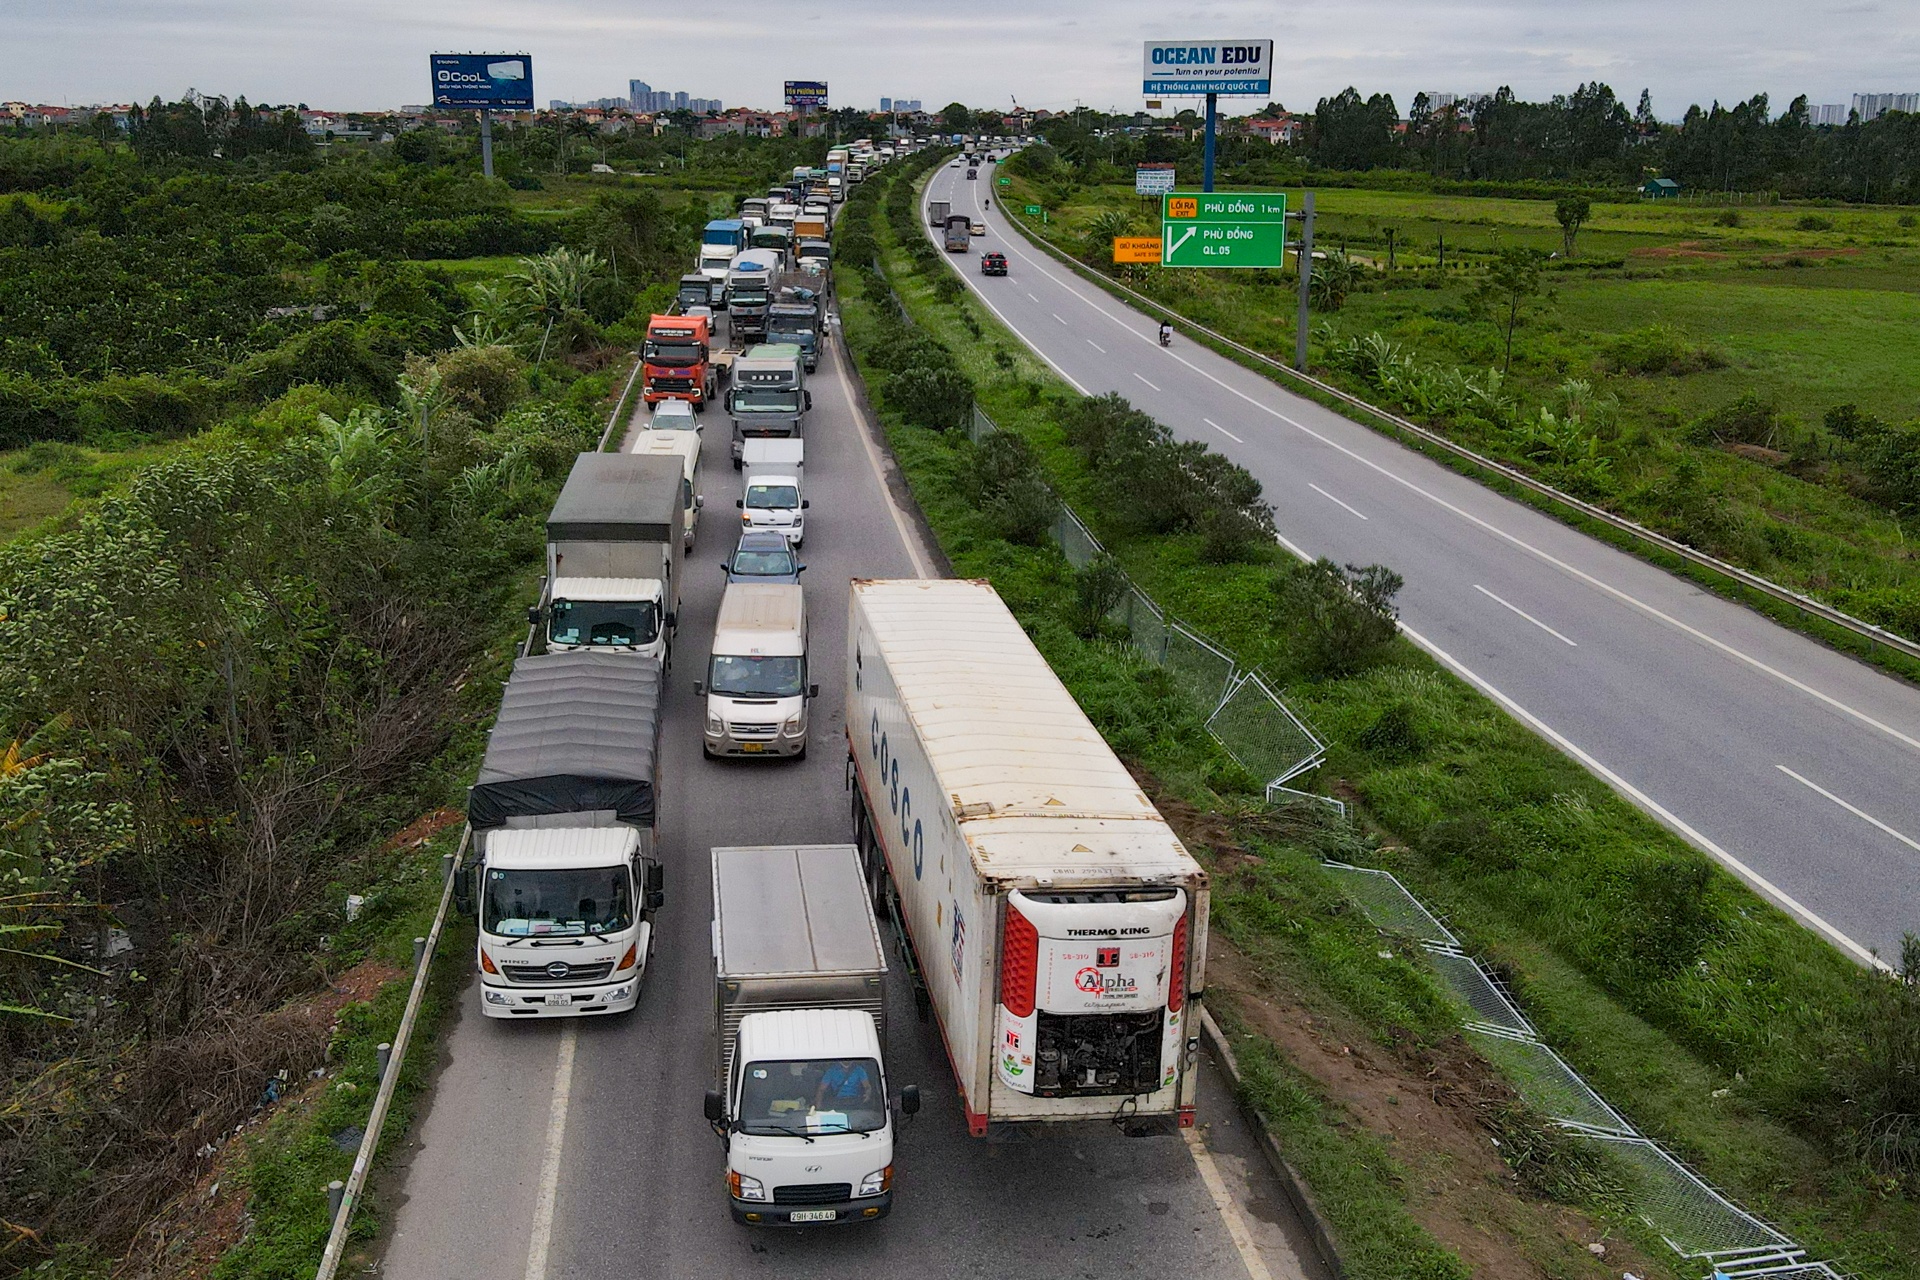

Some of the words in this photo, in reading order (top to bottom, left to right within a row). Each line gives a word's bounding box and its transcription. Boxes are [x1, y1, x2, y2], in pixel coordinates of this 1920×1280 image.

[1152, 47, 1216, 64] OCEAN
[1222, 46, 1261, 64] EDU
[1205, 69, 1222, 77] your
[1224, 67, 1260, 76] potential
[1151, 83, 1161, 92] HỆ
[1163, 81, 1189, 91] THỐNG
[1190, 83, 1207, 91] ANH
[1208, 82, 1226, 91] NGỮ
[1227, 81, 1248, 92] QUỐC
[1250, 81, 1259, 90] TẾ
[1171, 200, 1183, 210] LỐI
[1184, 201, 1195, 210] RA
[1204, 200, 1225, 213] PHÙ
[1228, 199, 1254, 213] ĐỔNG
[1261, 204, 1265, 213] 1
[1267, 205, 1280, 213] km
[1203, 227, 1224, 239] PHÙ
[1227, 226, 1254, 239] ĐỔNG
[1132, 240, 1159, 249] KHOẢNG
[1203, 246, 1230, 255] QL.05
[871, 707, 923, 881] COSCO
[1067, 927, 1118, 936] THERMO
[1120, 926, 1151, 935] KING
[1129, 951, 1155, 959] SB-310
[1083, 972, 1136, 994] Alpha
